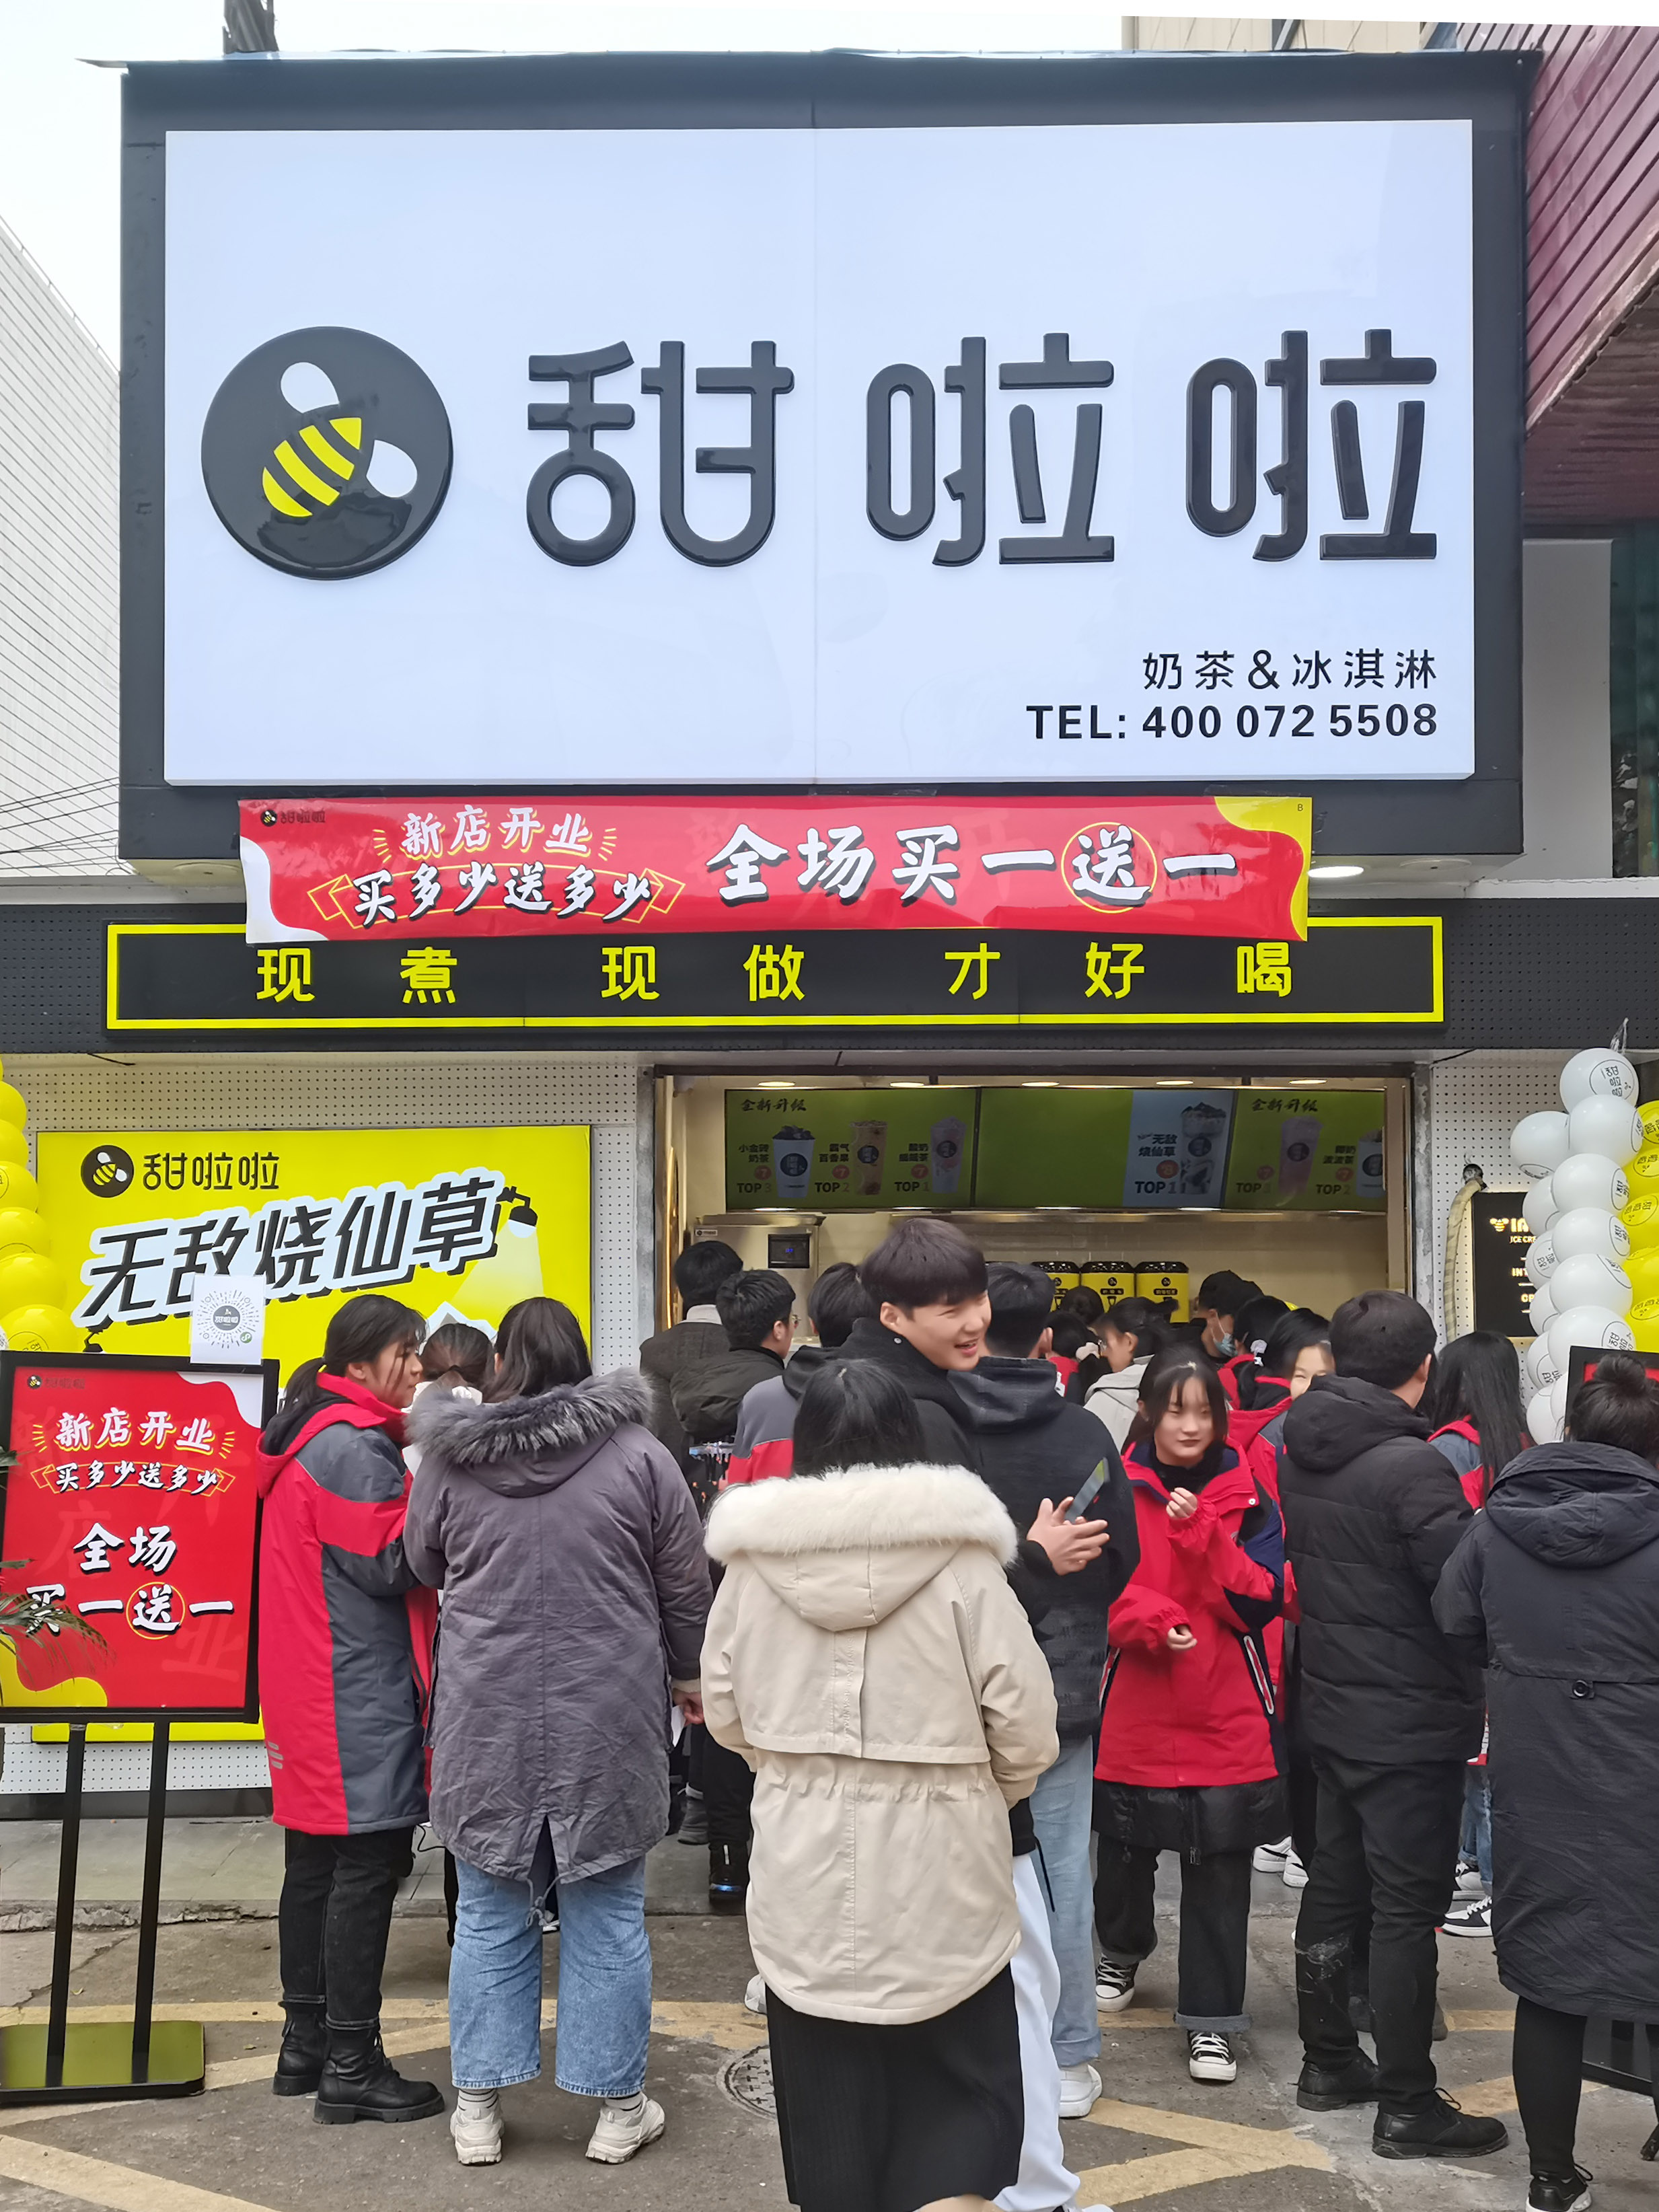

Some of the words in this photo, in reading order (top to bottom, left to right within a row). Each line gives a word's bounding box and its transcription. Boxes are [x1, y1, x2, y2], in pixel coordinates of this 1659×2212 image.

[527, 329, 1436, 567] 甜啦啦
[1143, 649, 1436, 690] 奶茶&冰淇淋
[1027, 705, 1125, 739] TEL:
[1143, 706, 1220, 737] 400
[1237, 705, 1314, 737] 072
[1330, 704, 1436, 736] 5508
[402, 805, 589, 856] 新店开业
[706, 822, 1238, 904] 全场买一送一
[353, 862, 650, 926] 买多少送多少
[257, 947, 457, 1003] 现煮
[602, 945, 805, 1001] 现做
[945, 943, 1291, 999] 才好喝
[143, 1152, 279, 1190] 甜啦啦
[737, 1183, 762, 1193] TOP
[815, 1182, 841, 1192] TOP
[842, 1182, 850, 1192] 2
[895, 1182, 920, 1191] TOP
[1135, 1181, 1166, 1194] TOP
[1237, 1183, 1261, 1193] TOP
[1316, 1184, 1341, 1194] TOP
[81, 1177, 495, 1318] 无敌烧仙草
[57, 1407, 214, 1454] 新店开业
[57, 1461, 217, 1495] 买多少送多少
[74, 1523, 176, 1574] 全场
[27, 1583, 233, 1633] 买一送一
